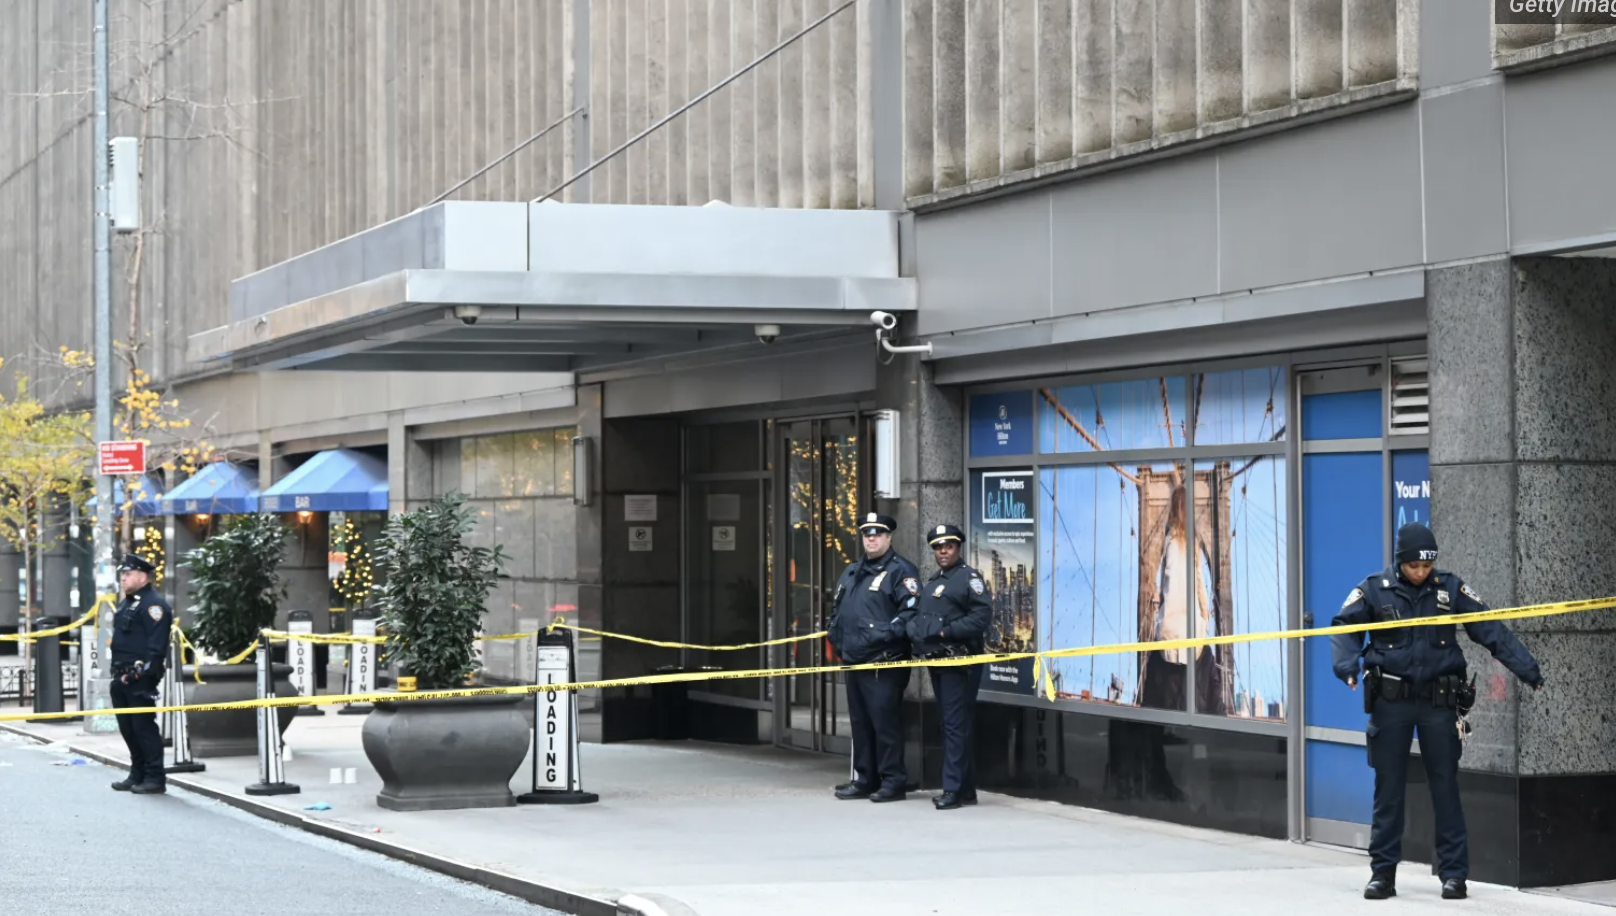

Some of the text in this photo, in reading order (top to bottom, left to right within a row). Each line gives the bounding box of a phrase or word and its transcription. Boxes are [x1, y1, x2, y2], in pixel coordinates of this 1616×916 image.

[1000, 478, 1024, 489] Members
[1395, 481, 1420, 498] Your
[294, 495, 310, 509] BAR
[987, 490, 1026, 520] Get More
[1419, 550, 1438, 560] NYP
[297, 640, 305, 695] LOADIN
[359, 641, 368, 692] OADIN
[546, 673, 557, 782] LOADING
